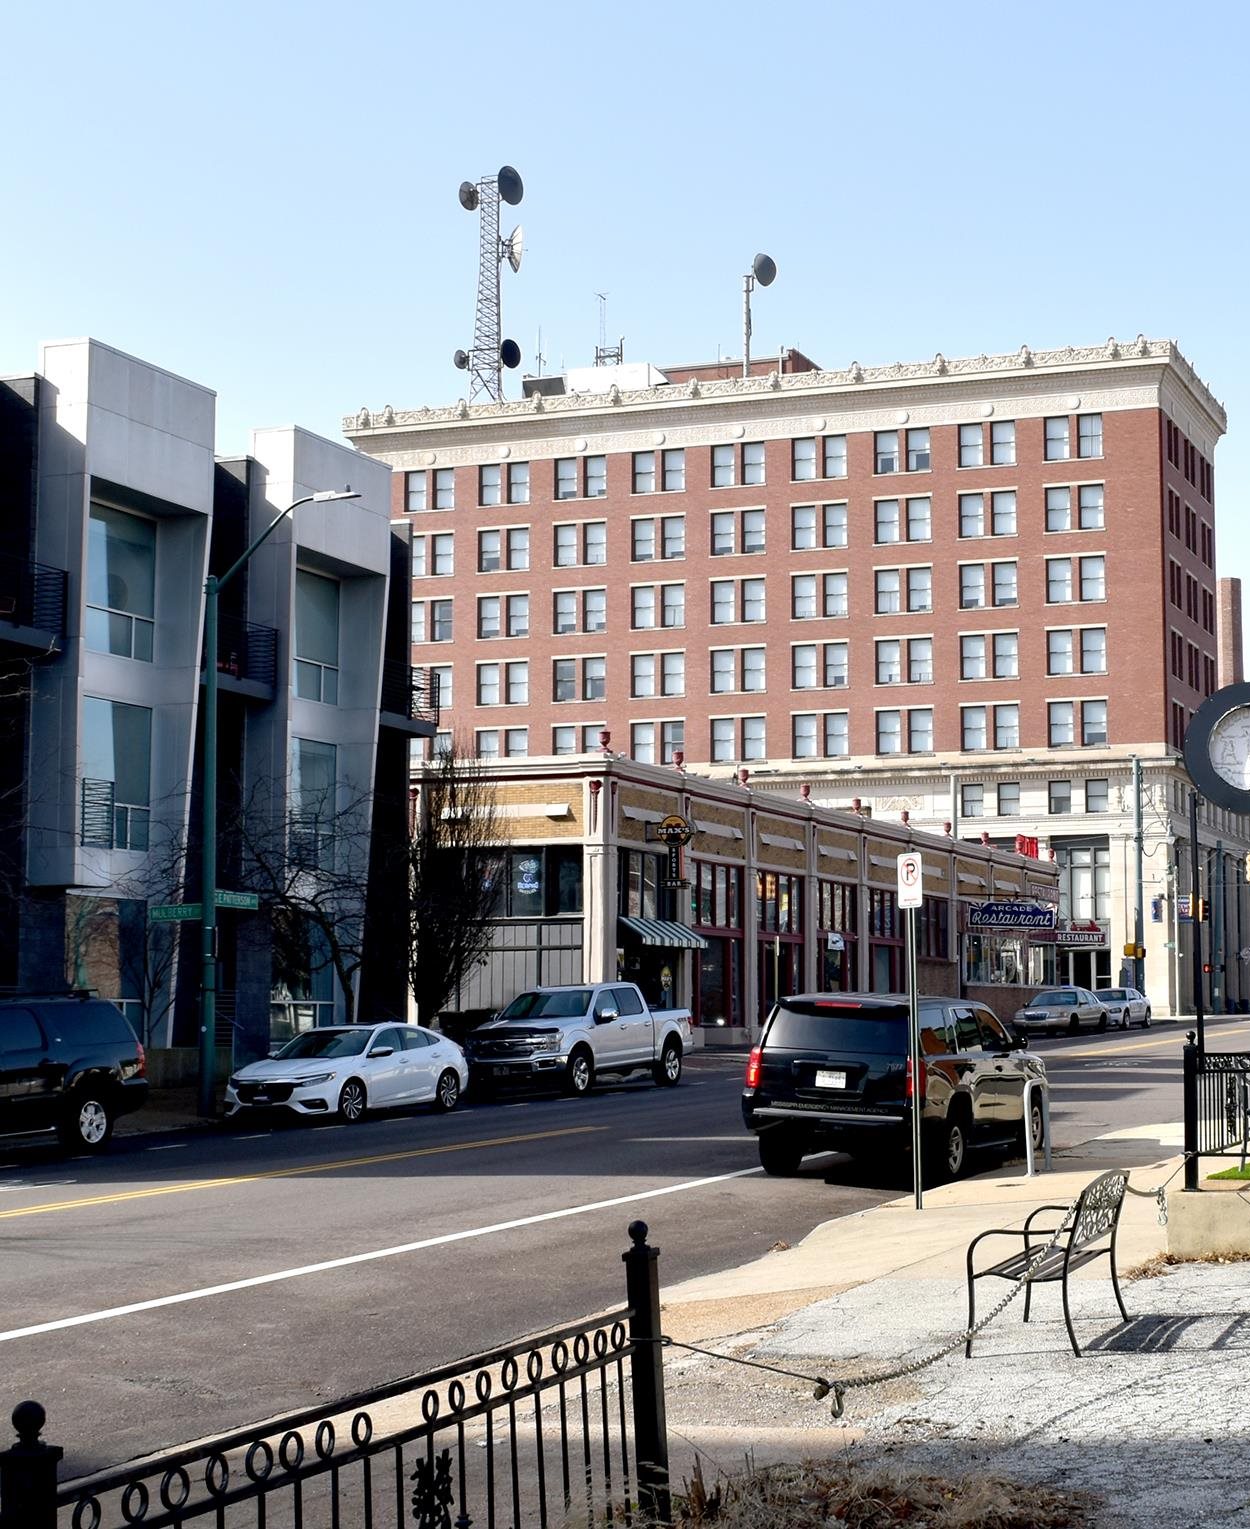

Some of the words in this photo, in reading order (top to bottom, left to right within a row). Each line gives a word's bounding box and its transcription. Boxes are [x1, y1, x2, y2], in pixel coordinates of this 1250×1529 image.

[152, 907, 193, 919] MULBERRY
[972, 911, 1052, 925] Restaurant
[1057, 933, 1103, 942] RESTAURANT
